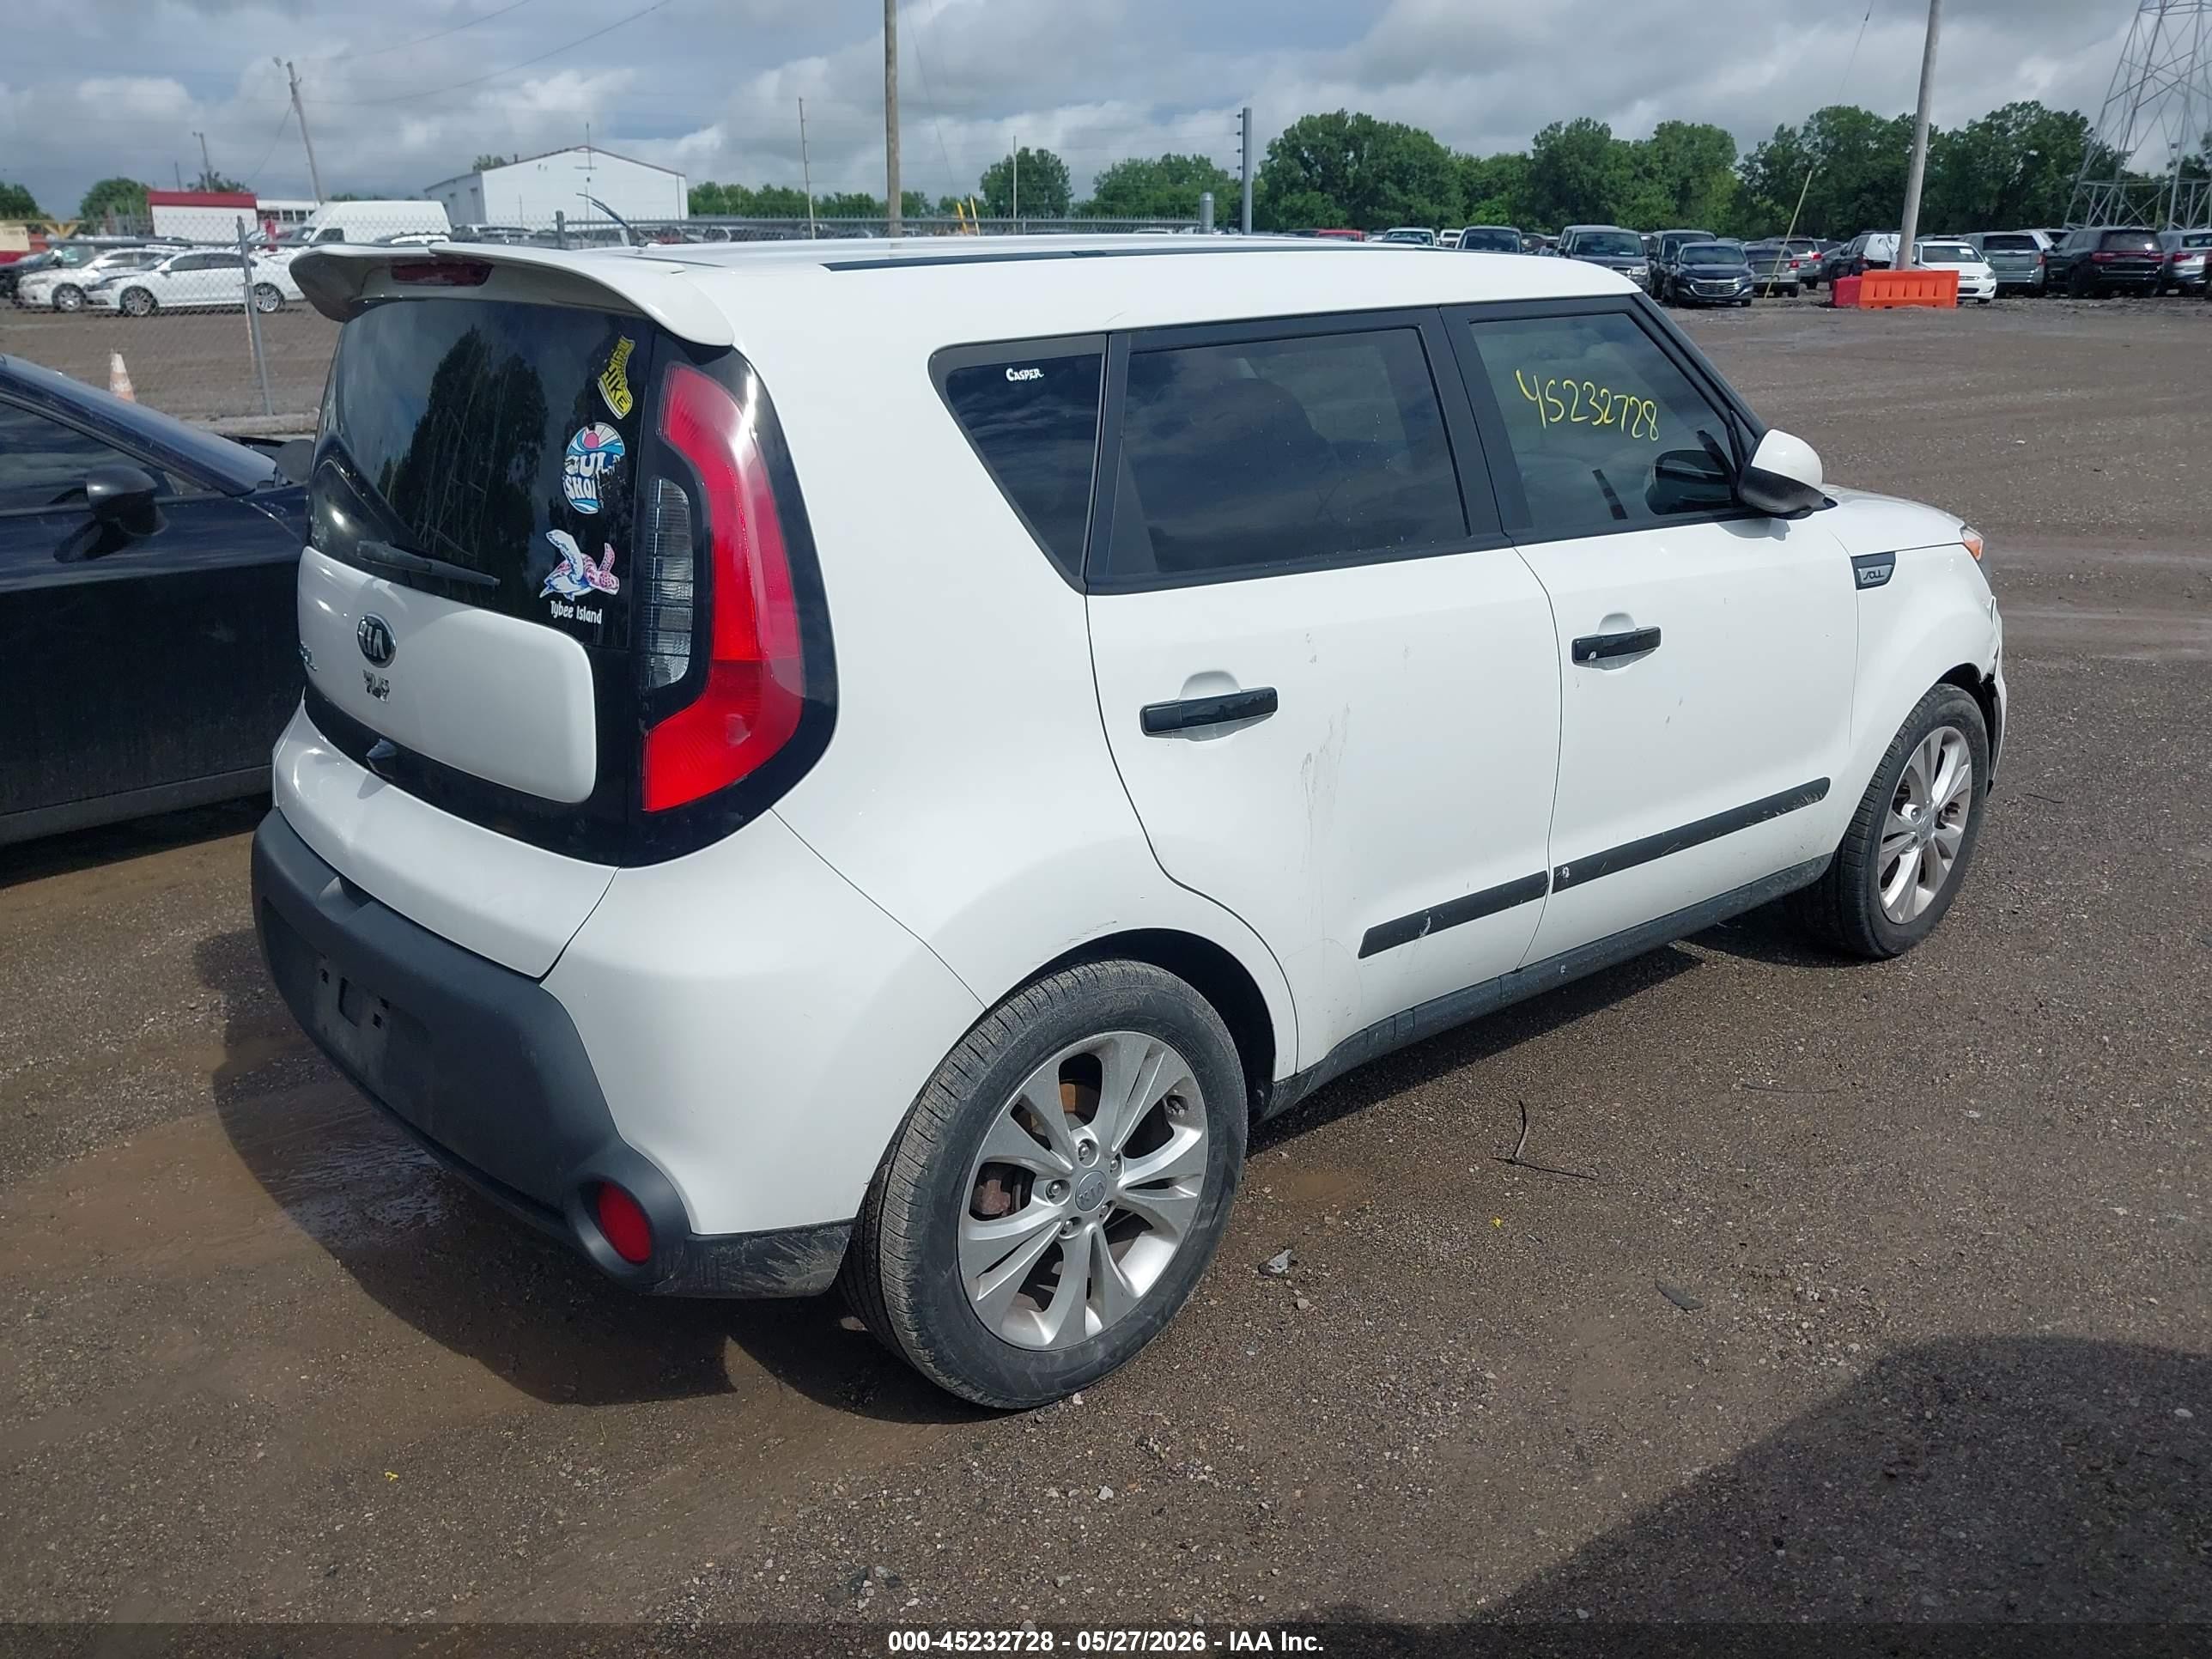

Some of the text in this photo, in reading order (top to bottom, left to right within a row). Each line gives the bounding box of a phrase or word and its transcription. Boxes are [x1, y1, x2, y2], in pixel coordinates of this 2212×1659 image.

[1516, 369, 1659, 441] 45232728
[550, 600, 603, 624] Tybee Island
